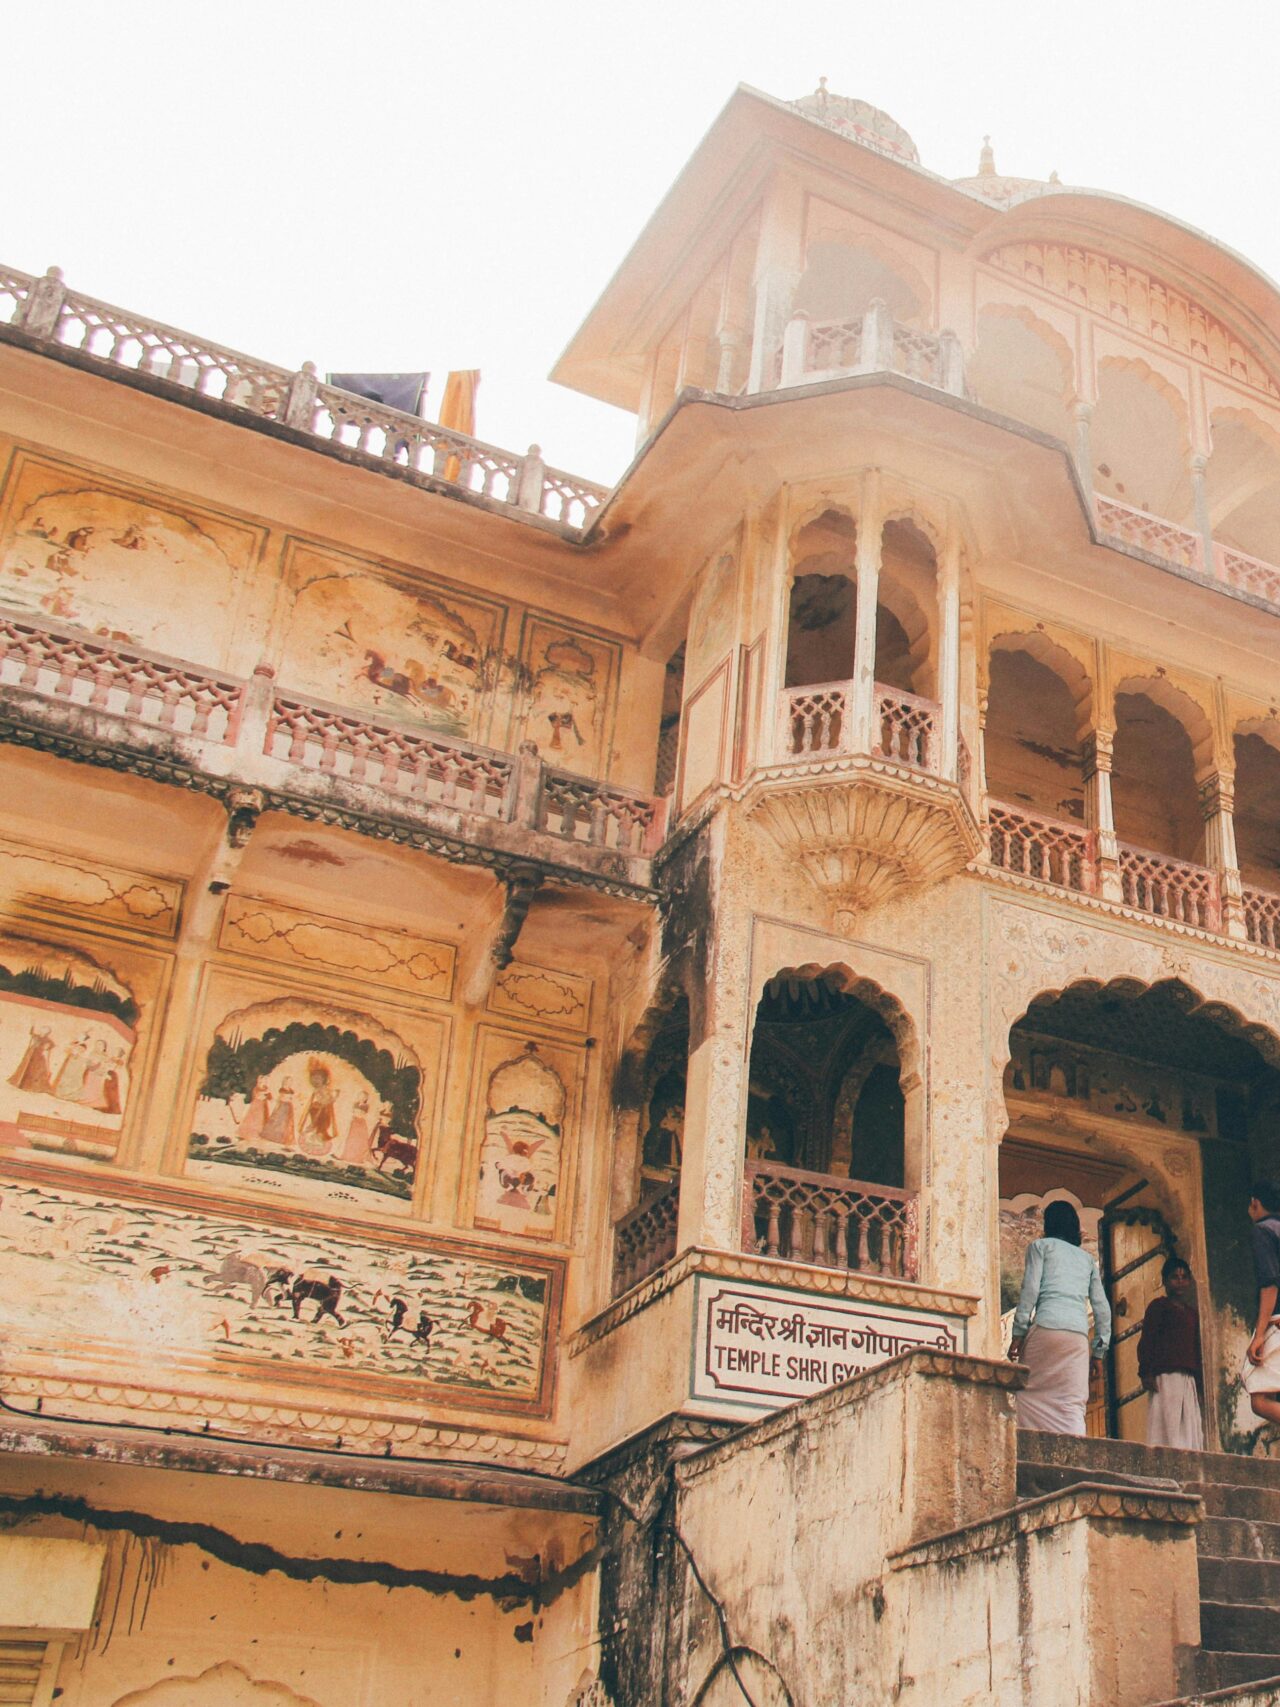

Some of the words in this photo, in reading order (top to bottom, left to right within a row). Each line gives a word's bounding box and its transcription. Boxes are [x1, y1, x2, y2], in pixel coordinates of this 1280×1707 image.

[716, 1303, 778, 1341] मन्दिर
[777, 1313, 807, 1344] श्री
[806, 1322, 850, 1350] ज्ञान
[714, 1345, 780, 1377] TEMPLE
[786, 1356, 827, 1384] SHRI
